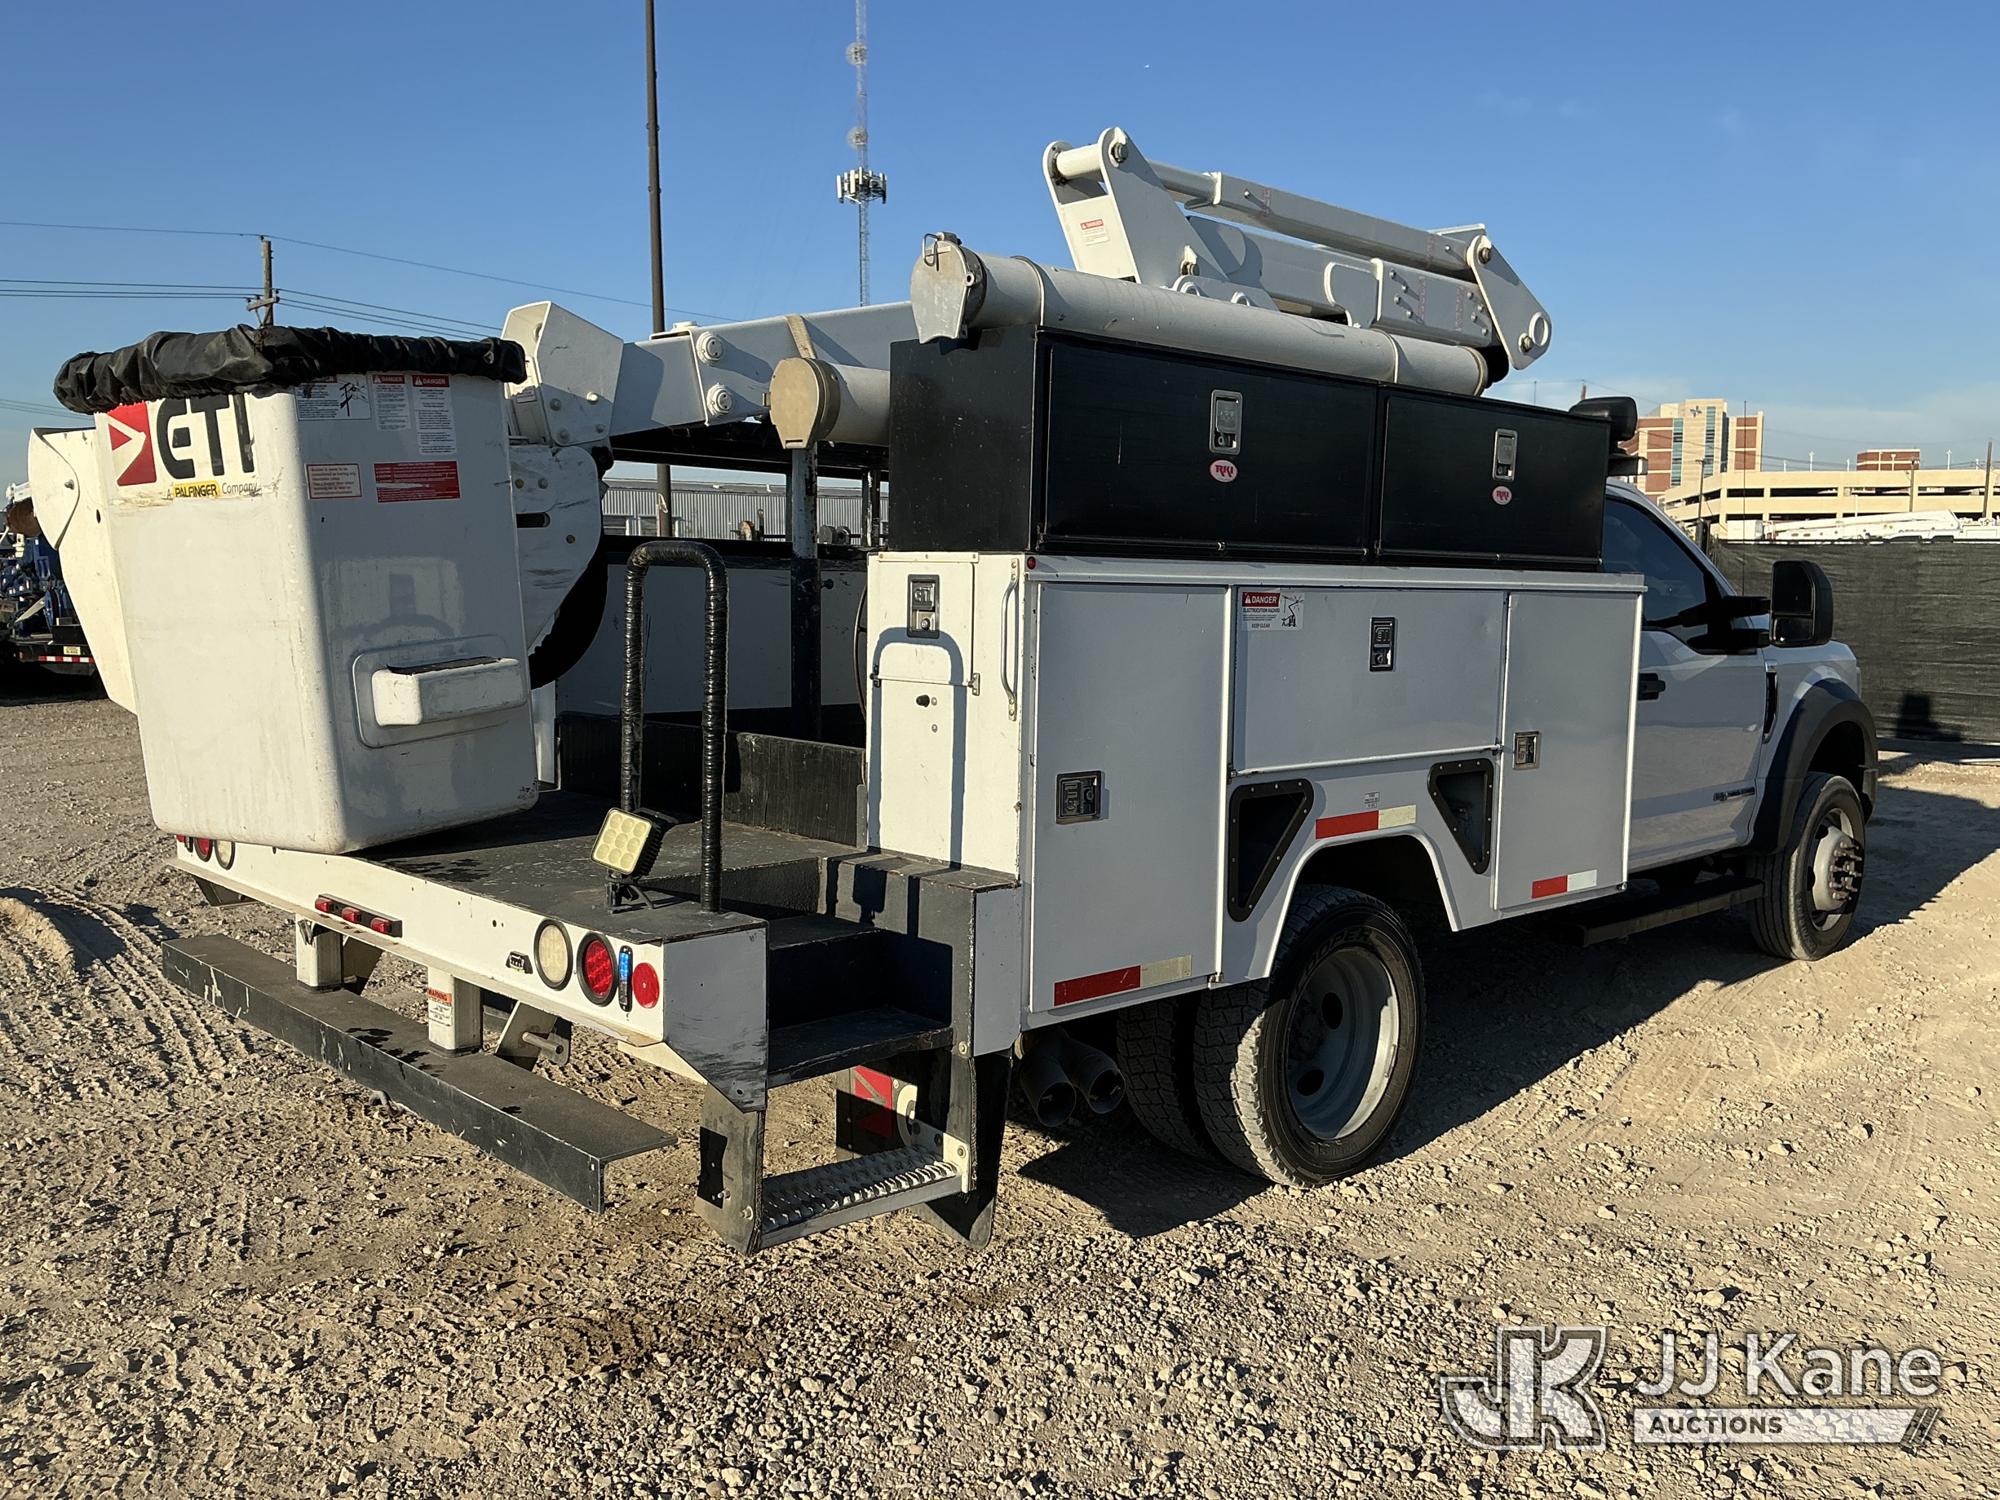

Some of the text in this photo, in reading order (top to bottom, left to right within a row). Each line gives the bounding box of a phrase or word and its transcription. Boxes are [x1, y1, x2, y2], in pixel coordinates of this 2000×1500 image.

[156, 393, 255, 479] ETI
[1215, 464, 1234, 477] RKI
[174, 484, 218, 498] PALFINGER
[221, 481, 258, 495] Company
[1251, 595, 1278, 604] DANGER
